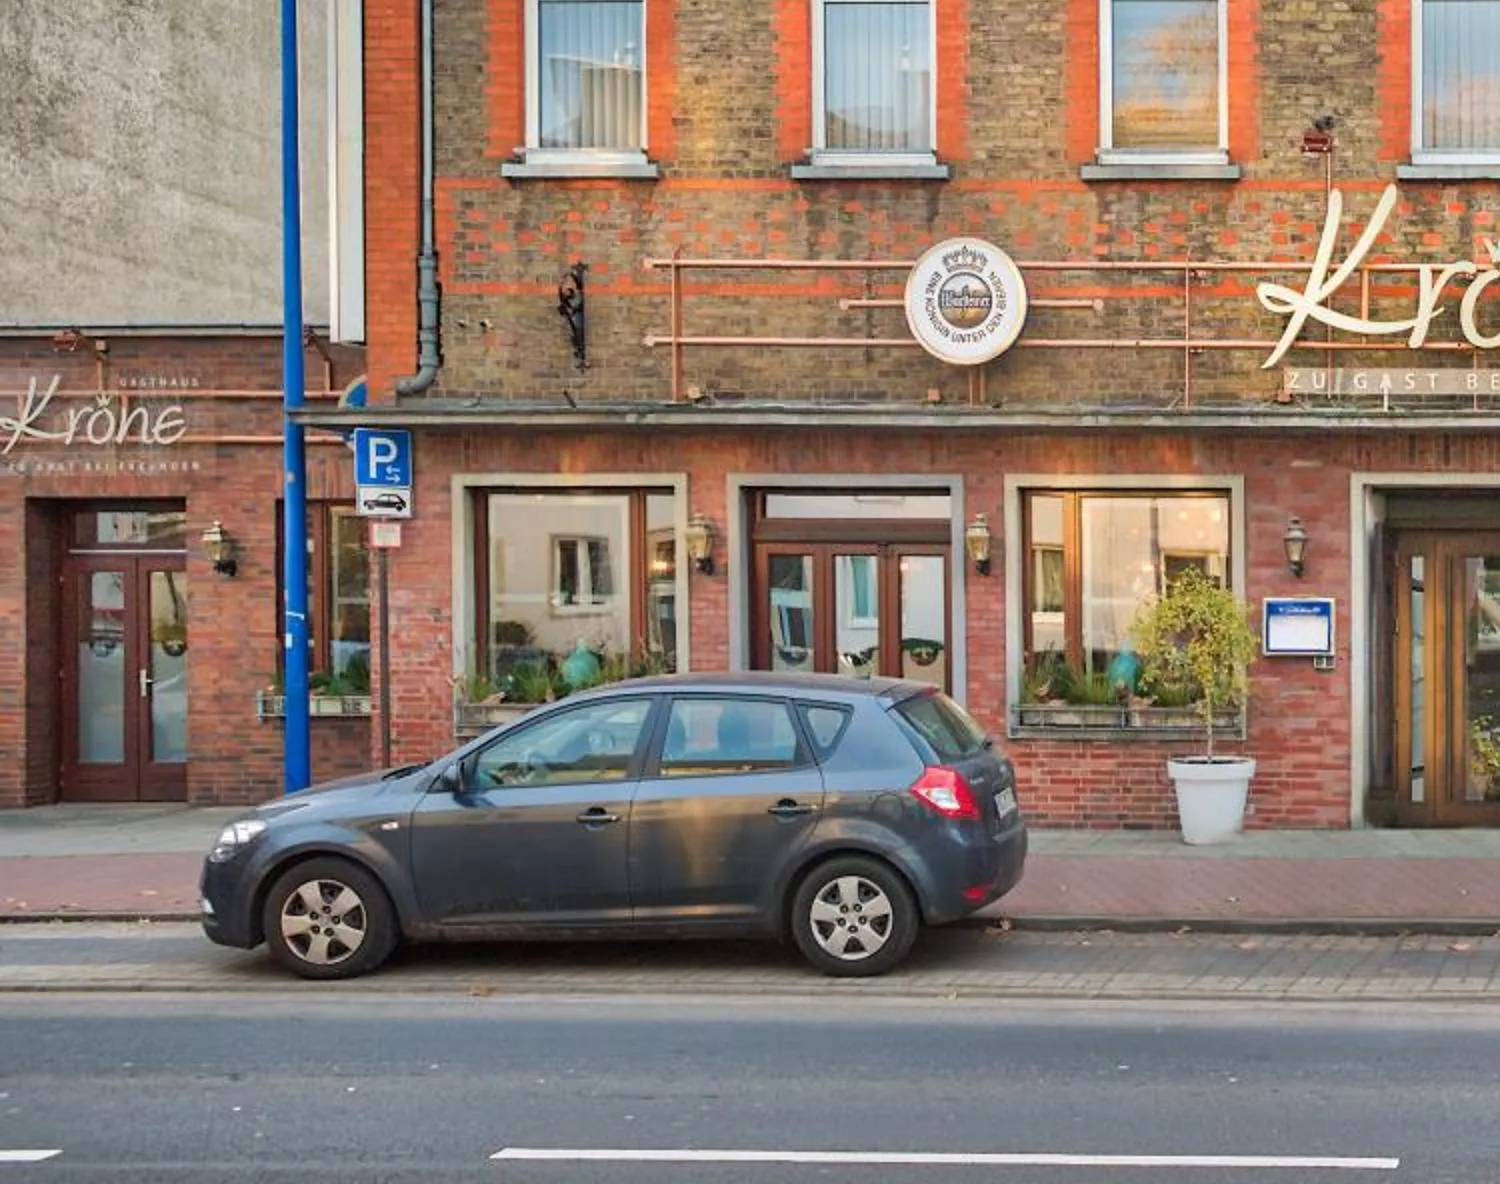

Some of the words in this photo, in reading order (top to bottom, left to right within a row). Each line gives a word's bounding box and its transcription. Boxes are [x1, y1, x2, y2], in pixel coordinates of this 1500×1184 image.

[1286, 372, 1325, 391] ZU
[1352, 372, 1440, 392] GAST
[368, 436, 399, 480] P
